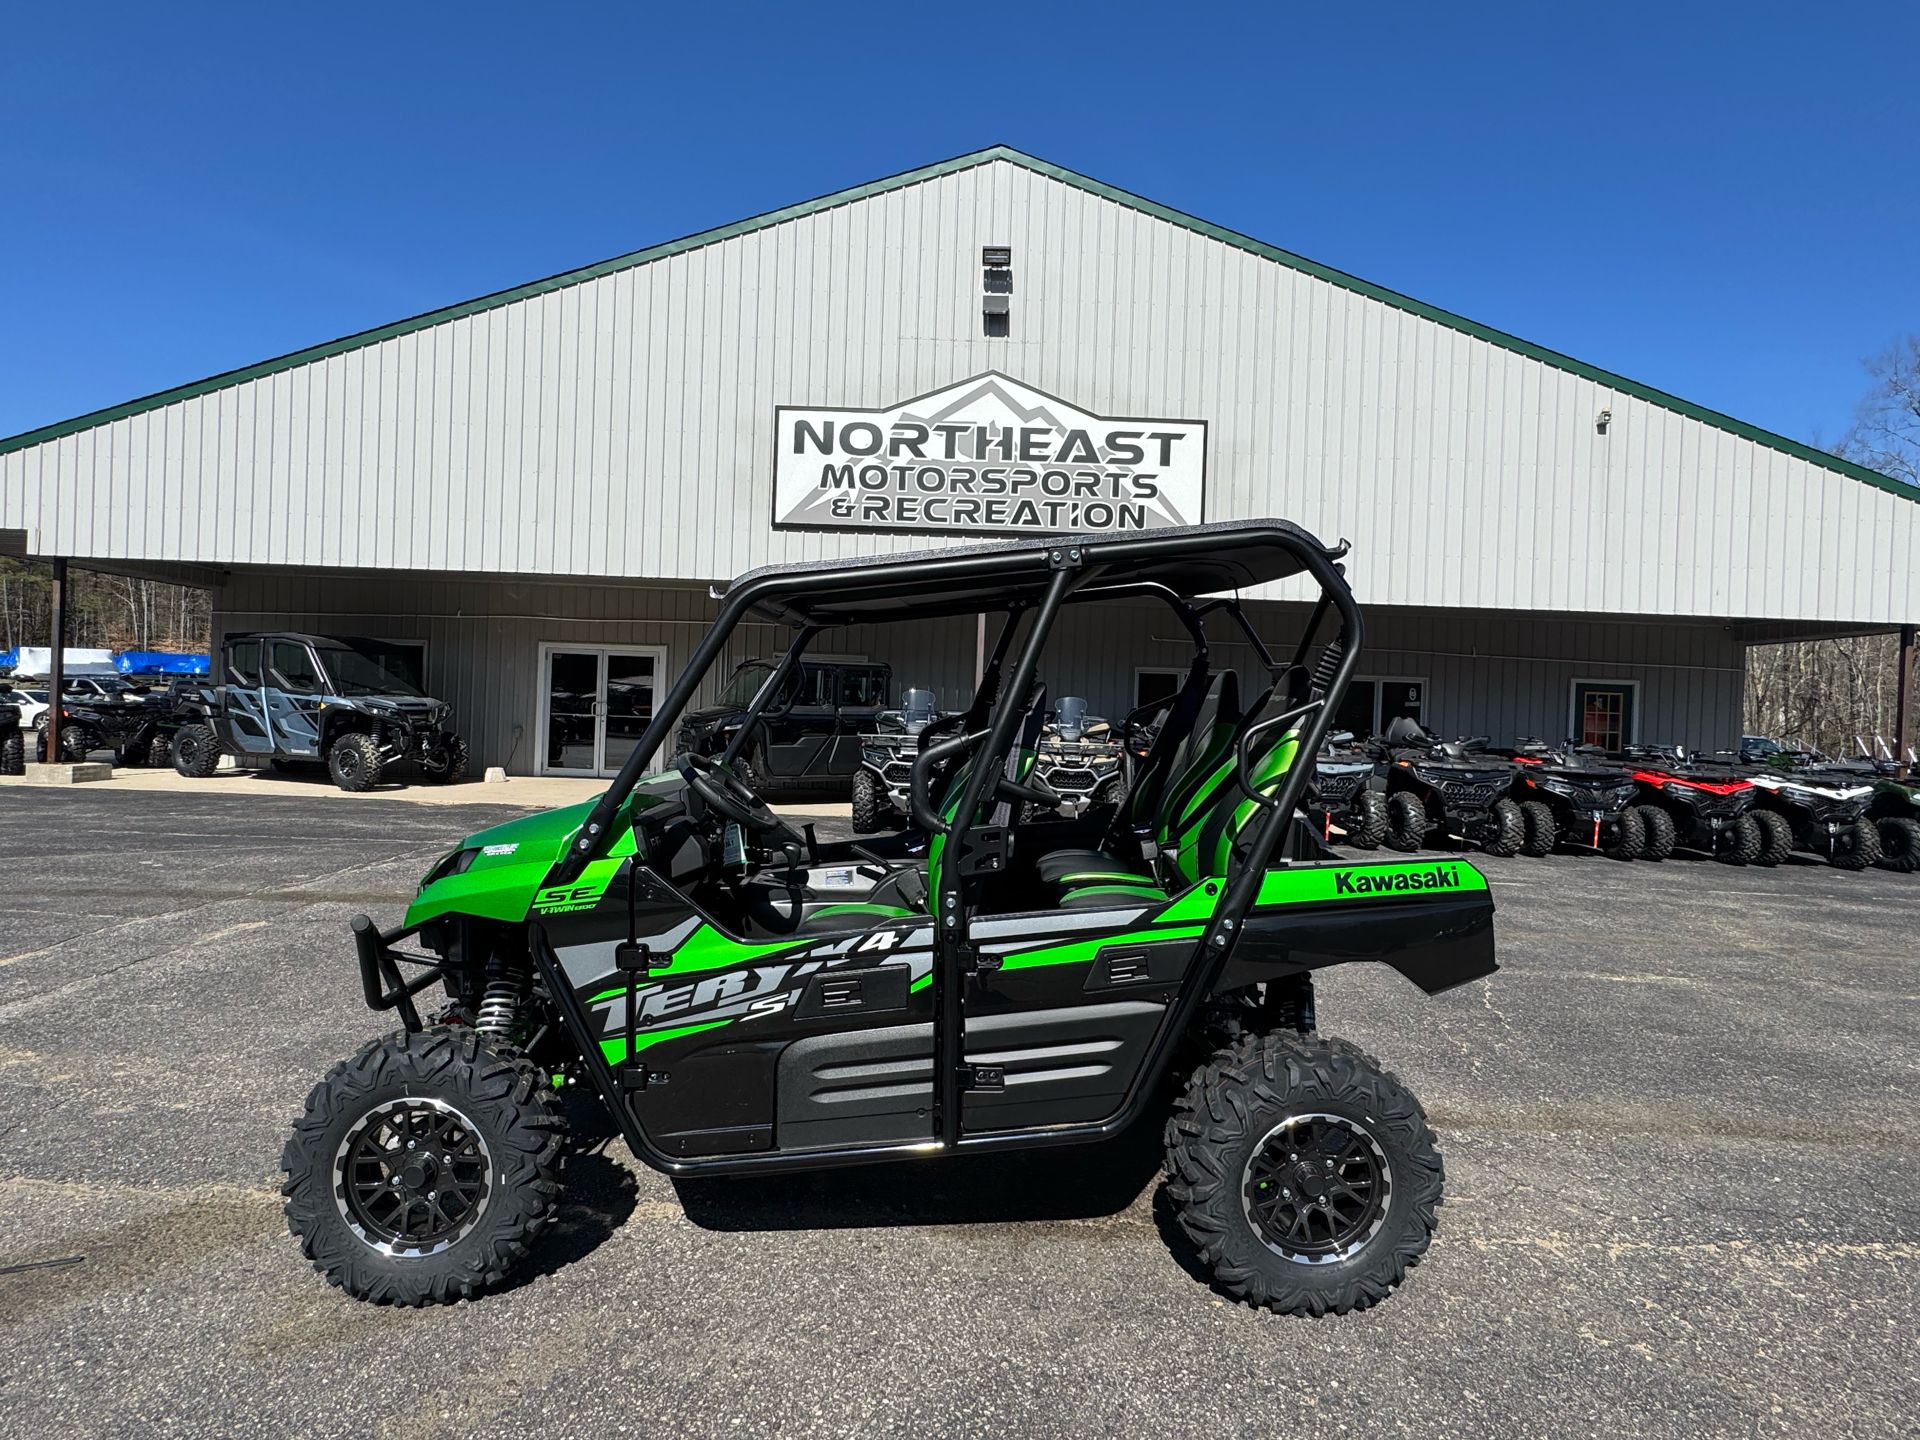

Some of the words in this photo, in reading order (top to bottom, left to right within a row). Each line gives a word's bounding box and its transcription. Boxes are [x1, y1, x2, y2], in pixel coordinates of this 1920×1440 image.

[794, 419, 1187, 466] NORTHEAST
[819, 463, 1158, 498] MOTORSPORTS
[535, 886, 602, 904] SE
[1334, 866, 1459, 894] Kawasaki
